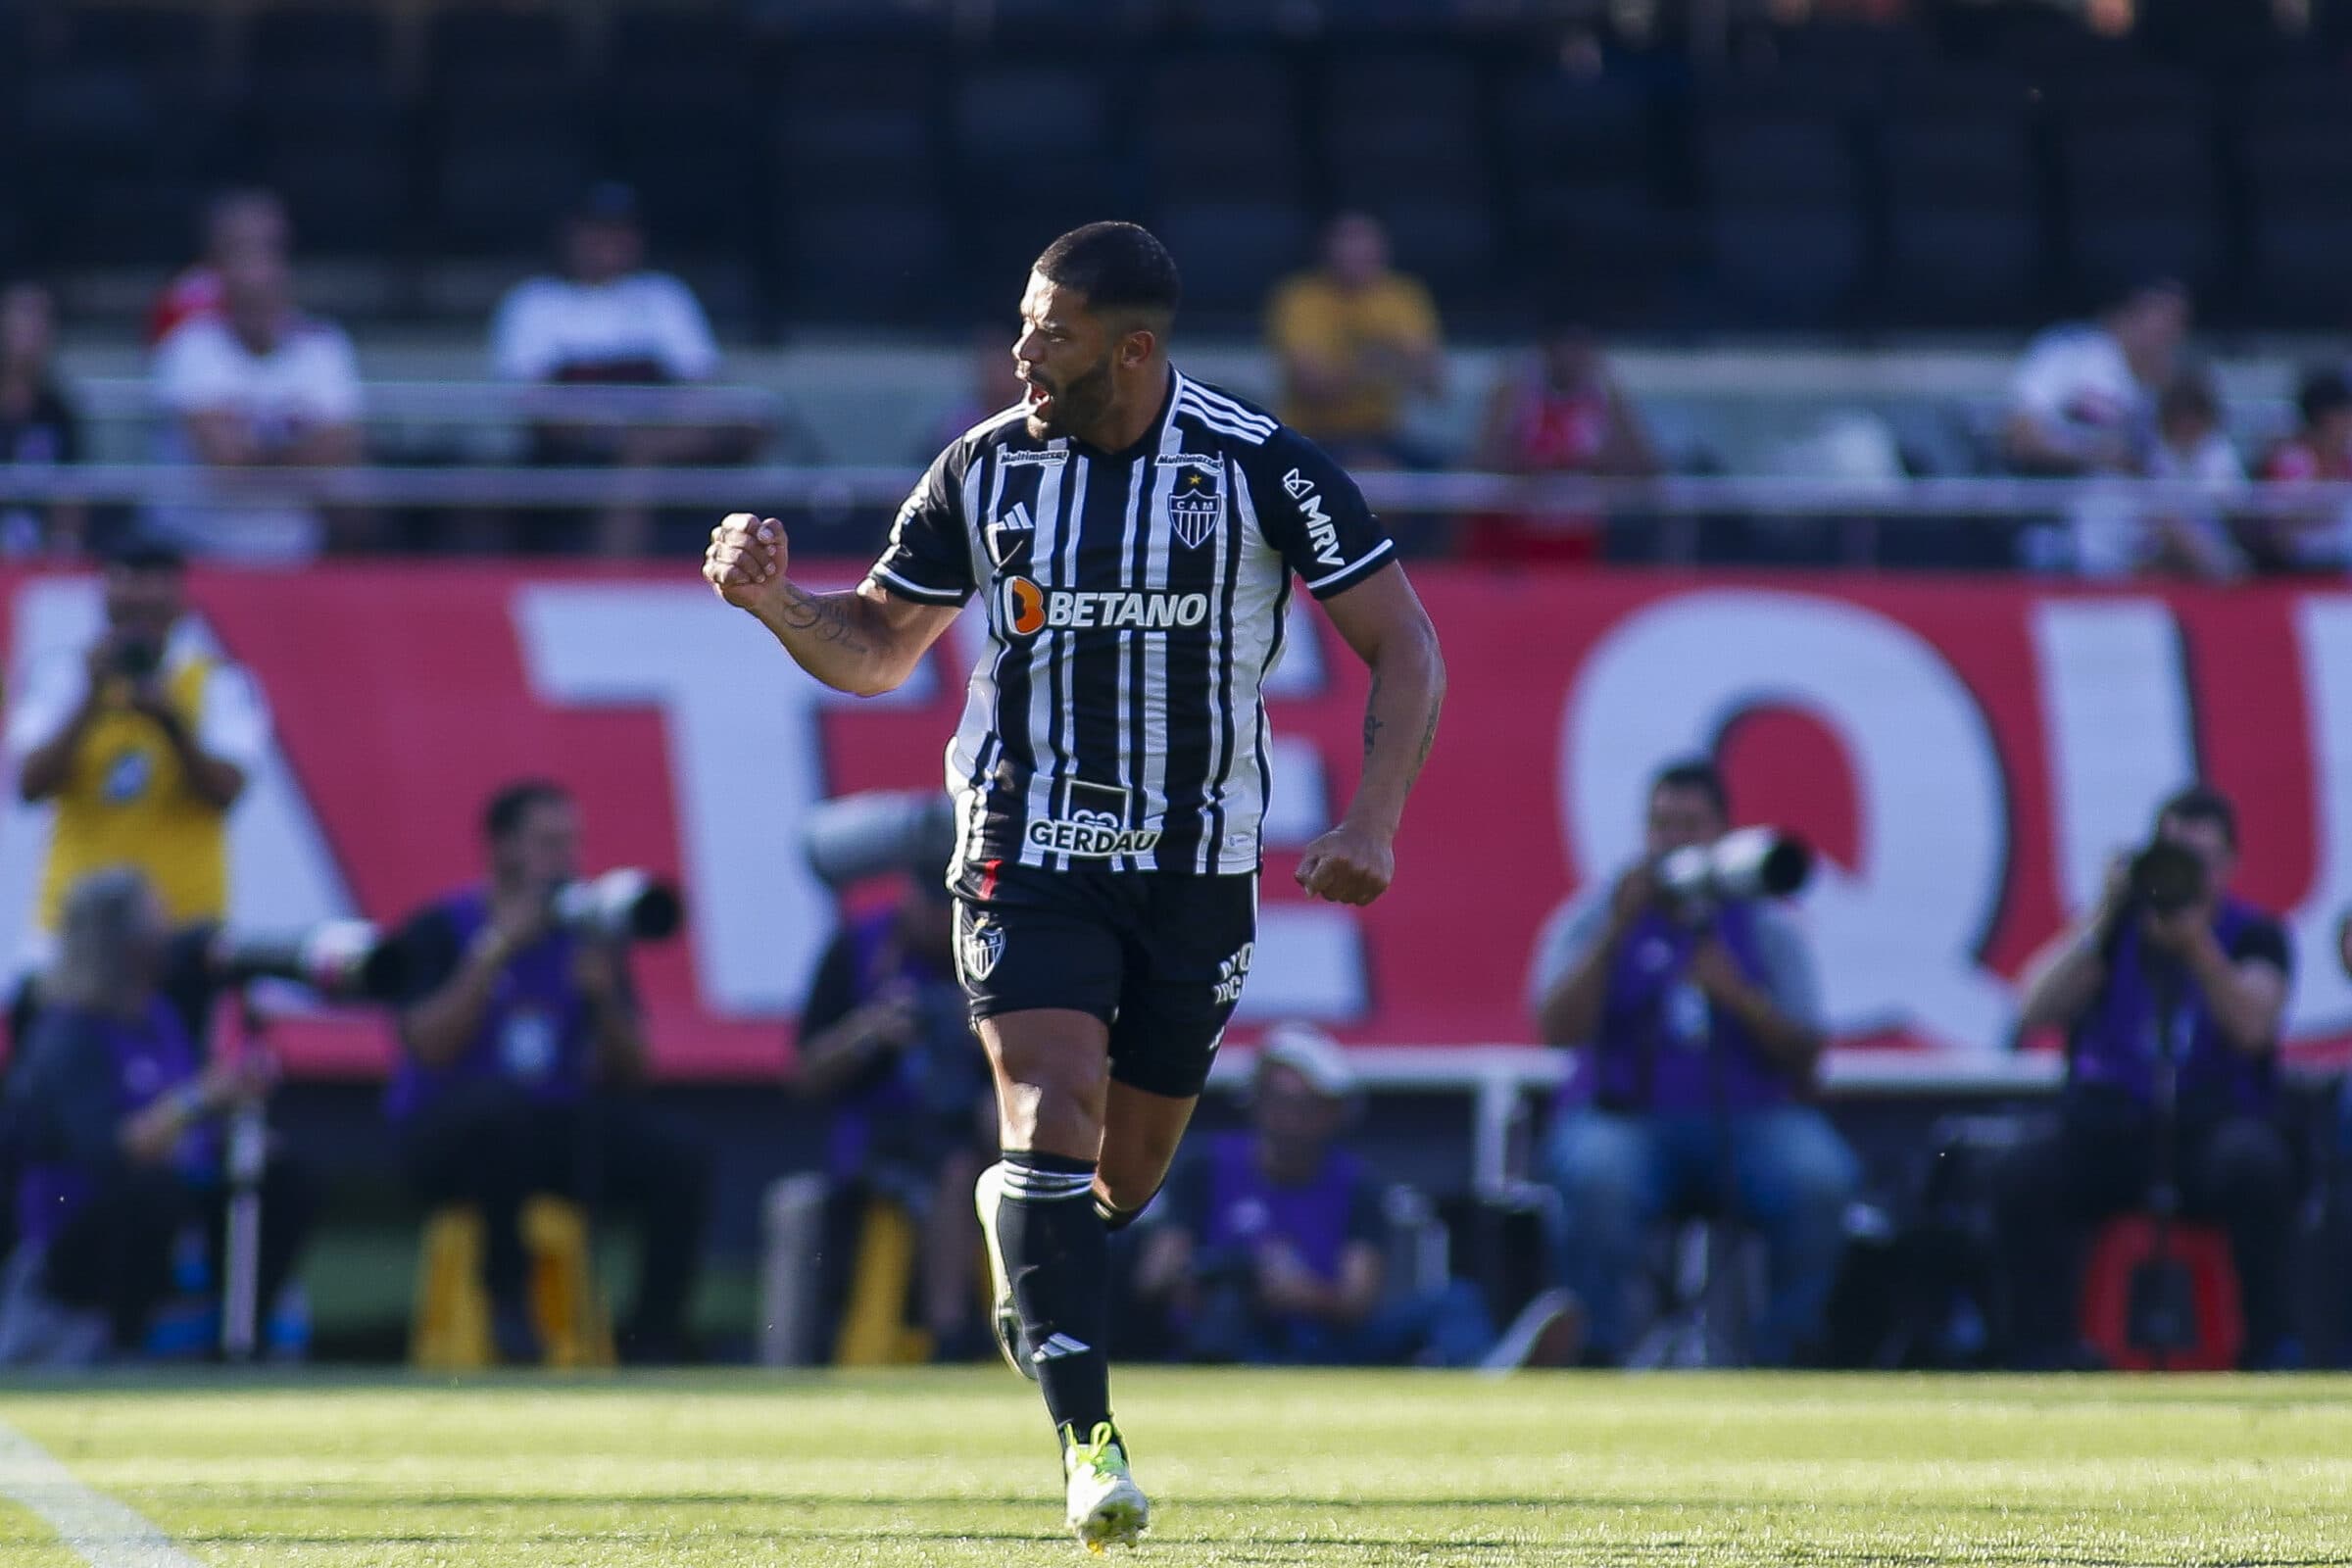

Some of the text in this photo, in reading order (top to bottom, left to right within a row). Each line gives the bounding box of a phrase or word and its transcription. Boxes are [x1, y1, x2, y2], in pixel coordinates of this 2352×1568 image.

[1001, 450, 1068, 465] Multimarcas
[1157, 453, 1223, 470] Multimarcas
[1299, 495, 1346, 565] MRV
[1048, 591, 1207, 627] BETANO
[1030, 821, 1158, 853] GERDAU
